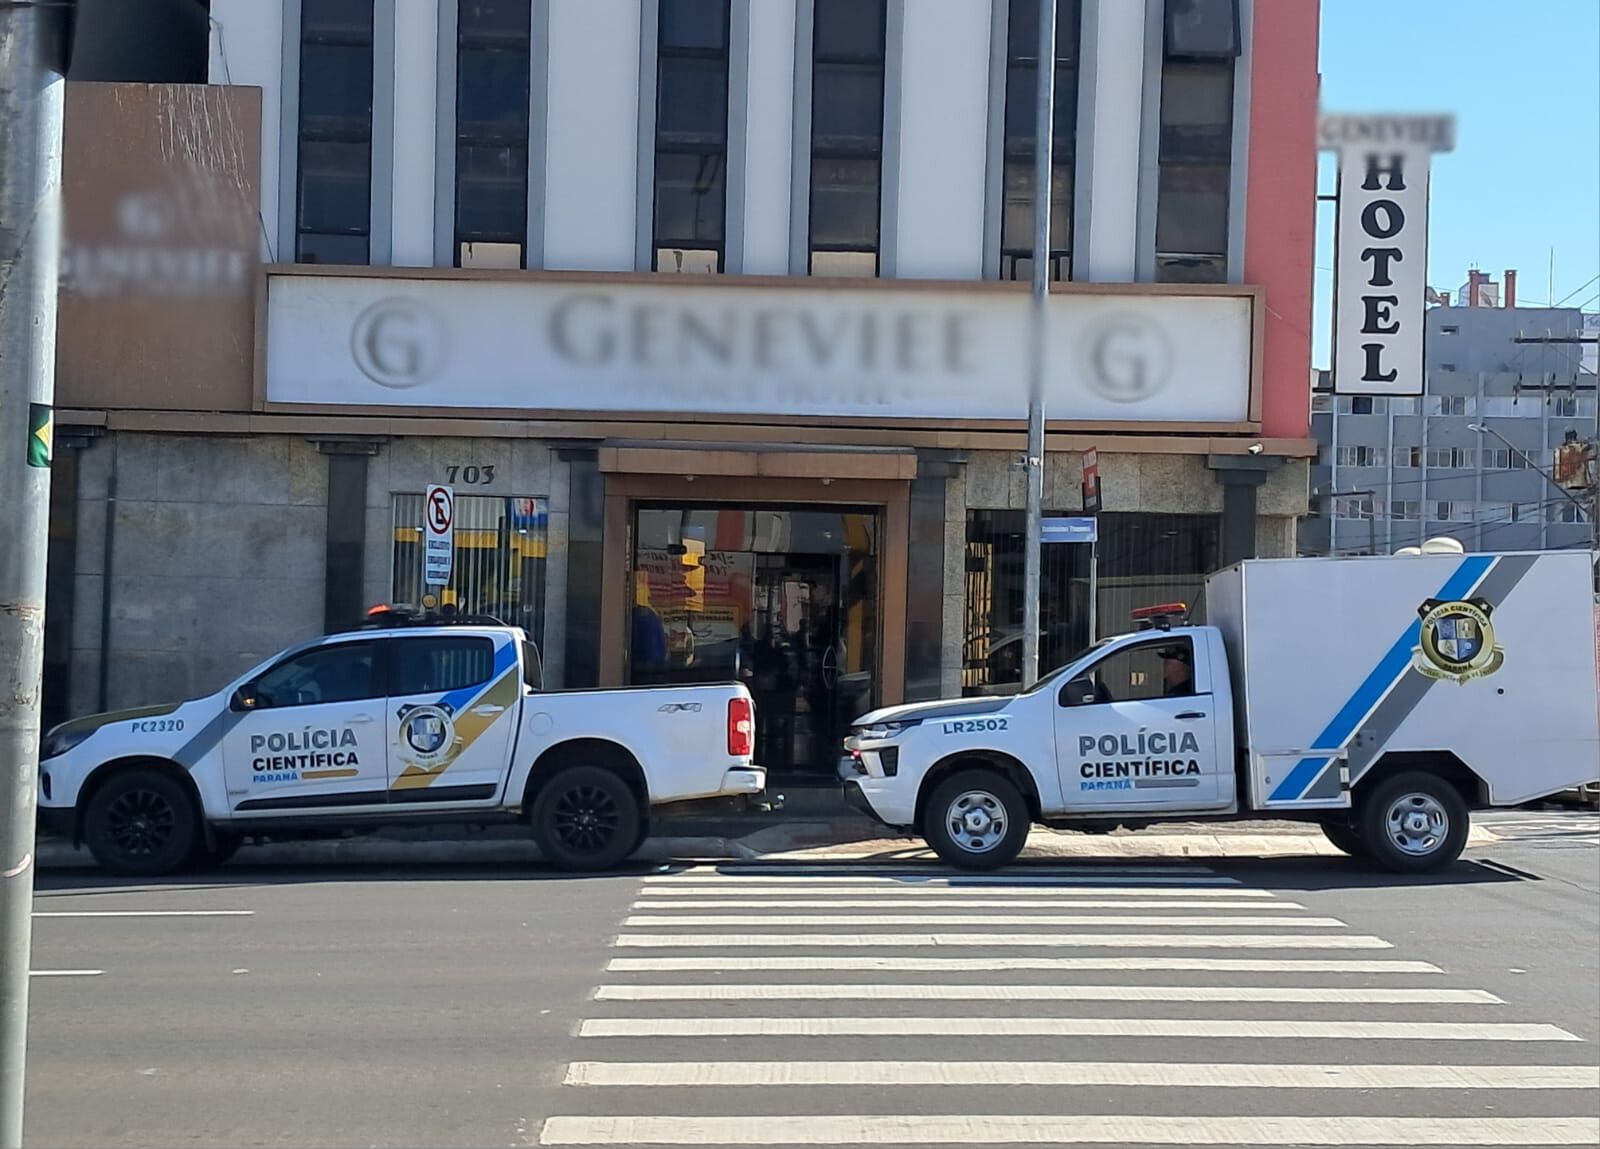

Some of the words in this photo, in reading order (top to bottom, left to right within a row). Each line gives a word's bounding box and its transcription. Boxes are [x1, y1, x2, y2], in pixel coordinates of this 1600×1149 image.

[1361, 153, 1406, 383] HOTEL
[446, 465, 495, 485] 703
[1425, 606, 1449, 629] POLÍCIA
[1450, 605, 1488, 628] CIENTÍFICA
[1444, 661, 1473, 673] PARANÁ
[131, 720, 184, 733] PC2320
[943, 718, 1009, 735] LR2502
[250, 725, 358, 754] POLÍCIA
[1079, 727, 1200, 757] POLÍCIA
[252, 751, 359, 772] CIENTÍFICA
[1080, 756, 1201, 778] CIENTÍFICA
[253, 772, 298, 783] PARANÁ
[1080, 778, 1132, 791] PARANÁ
